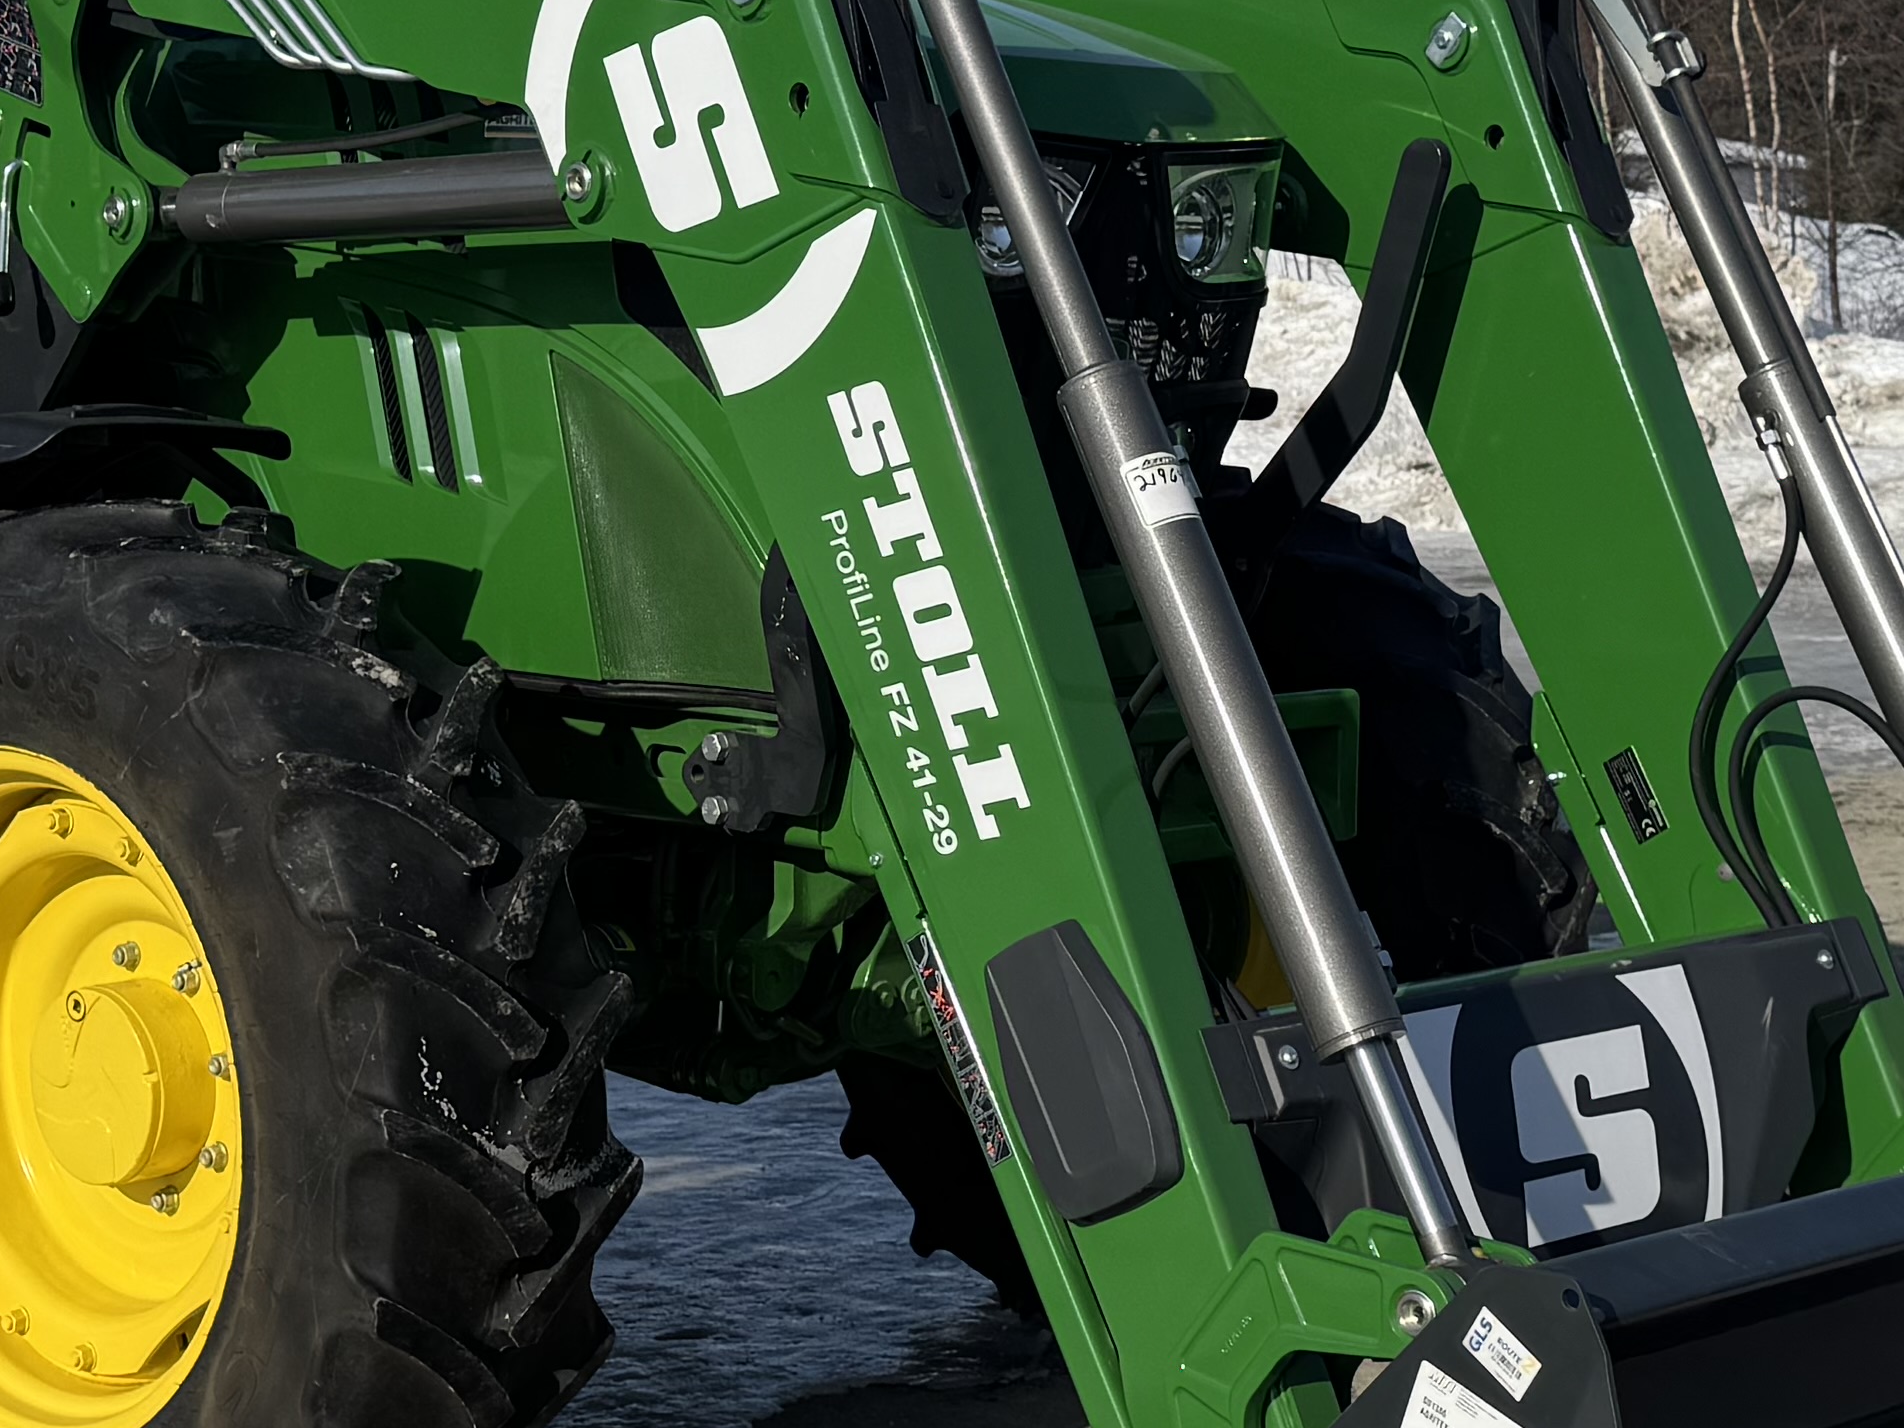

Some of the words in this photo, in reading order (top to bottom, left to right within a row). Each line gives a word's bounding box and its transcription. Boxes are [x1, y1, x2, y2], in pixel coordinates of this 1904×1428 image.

[603, 16, 779, 232] S
[821, 510, 889, 673] ProfiLine
[881, 682, 919, 738] FZ
[904, 746, 958, 856] 41-29
[827, 381, 1031, 840] STOLL
[1511, 1025, 1660, 1248] S
[1469, 1316, 1493, 1352] GLS
